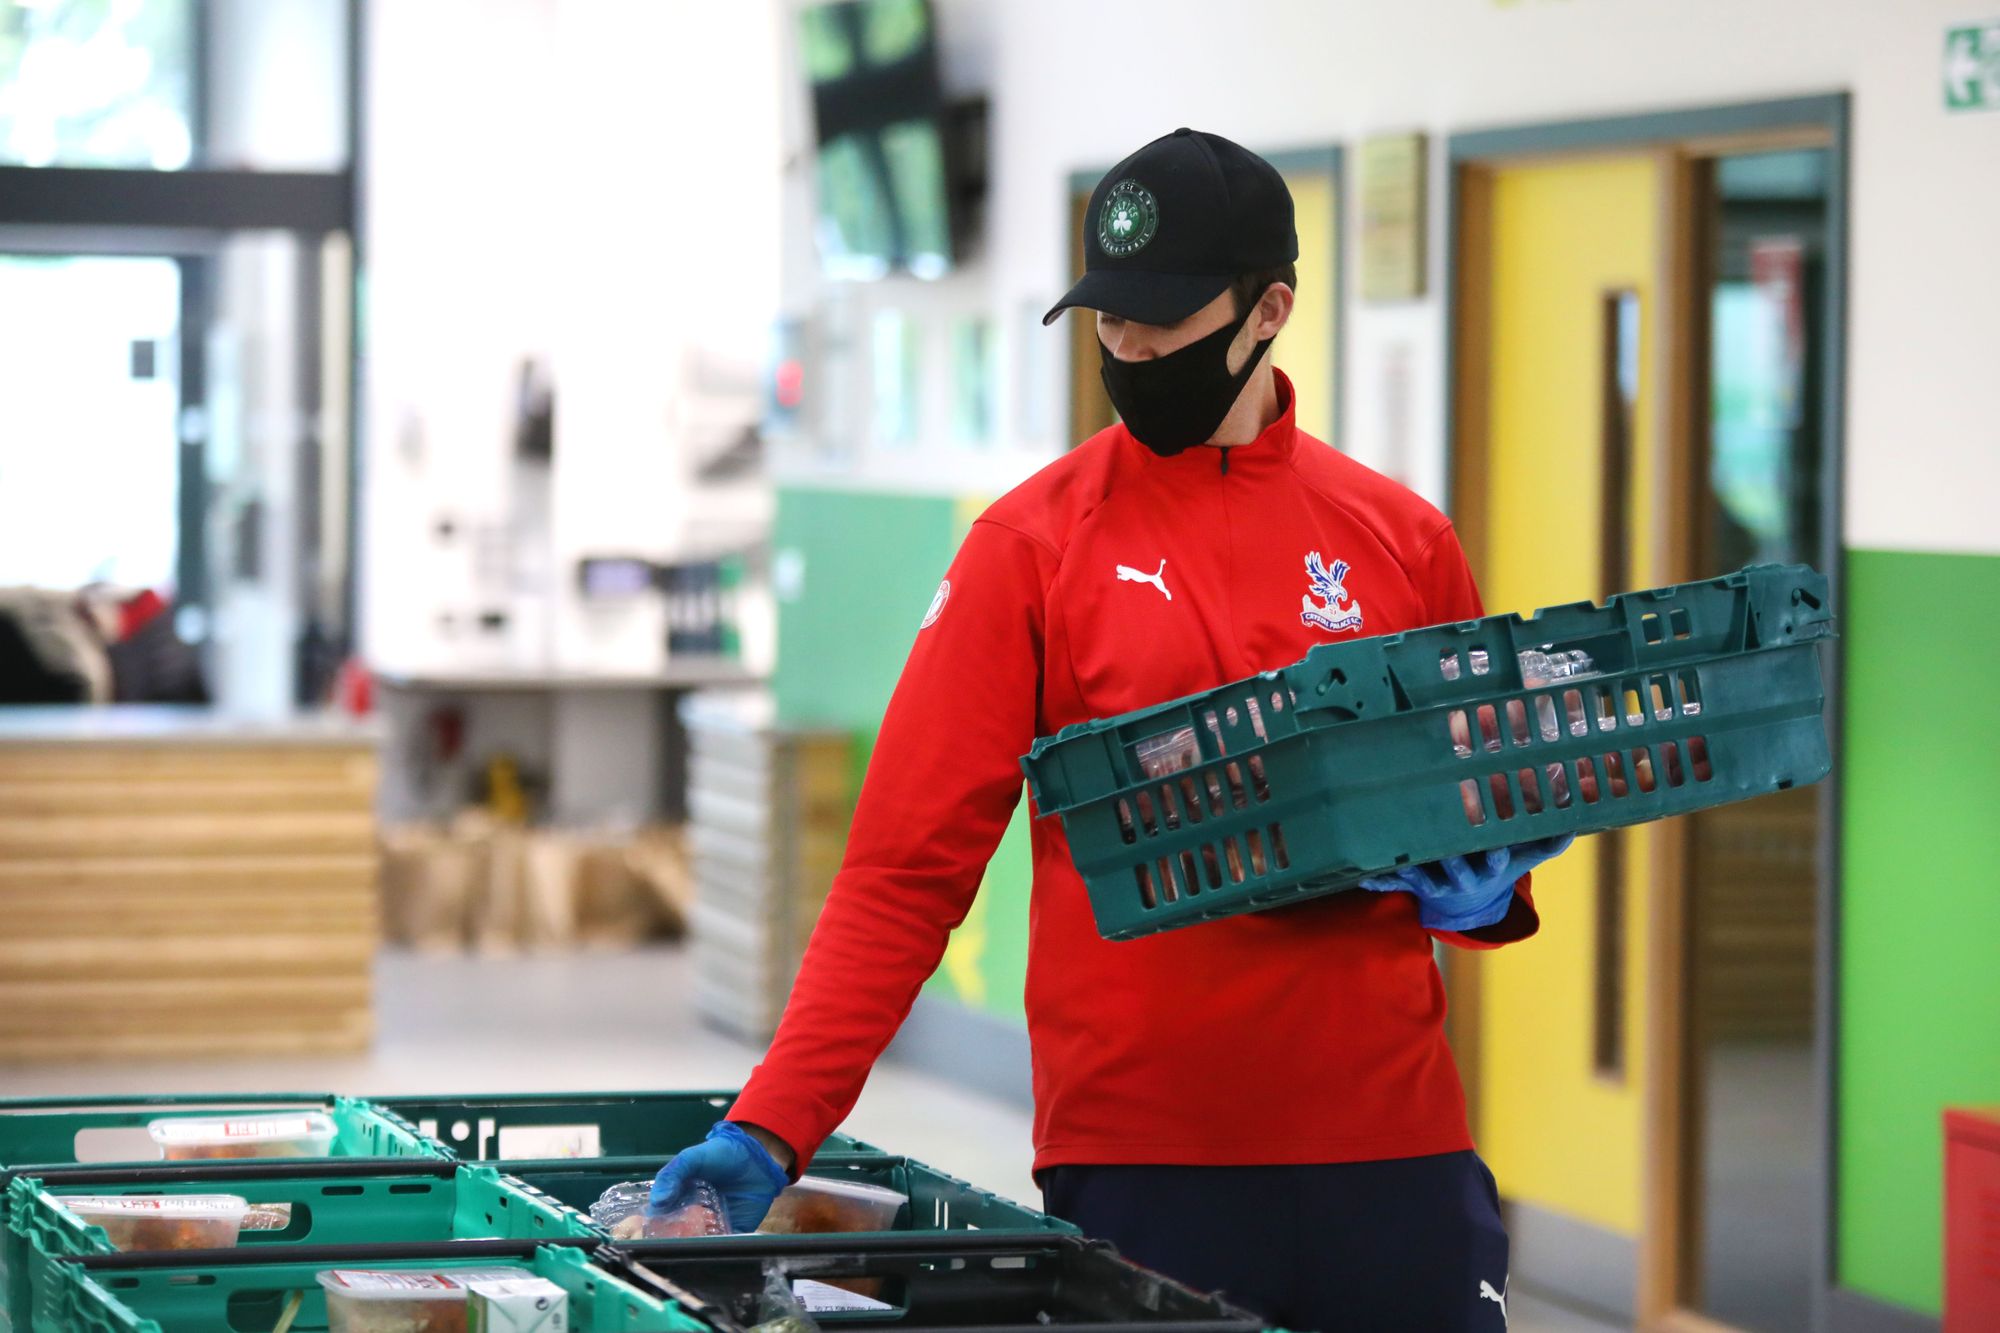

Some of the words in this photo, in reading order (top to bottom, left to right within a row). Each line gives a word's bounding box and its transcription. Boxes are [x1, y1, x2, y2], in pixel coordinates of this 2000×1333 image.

[1111, 201, 1138, 218] CELTICS
[1304, 613, 1330, 628] CRYSTAL
[1329, 618, 1351, 629] PALACE
